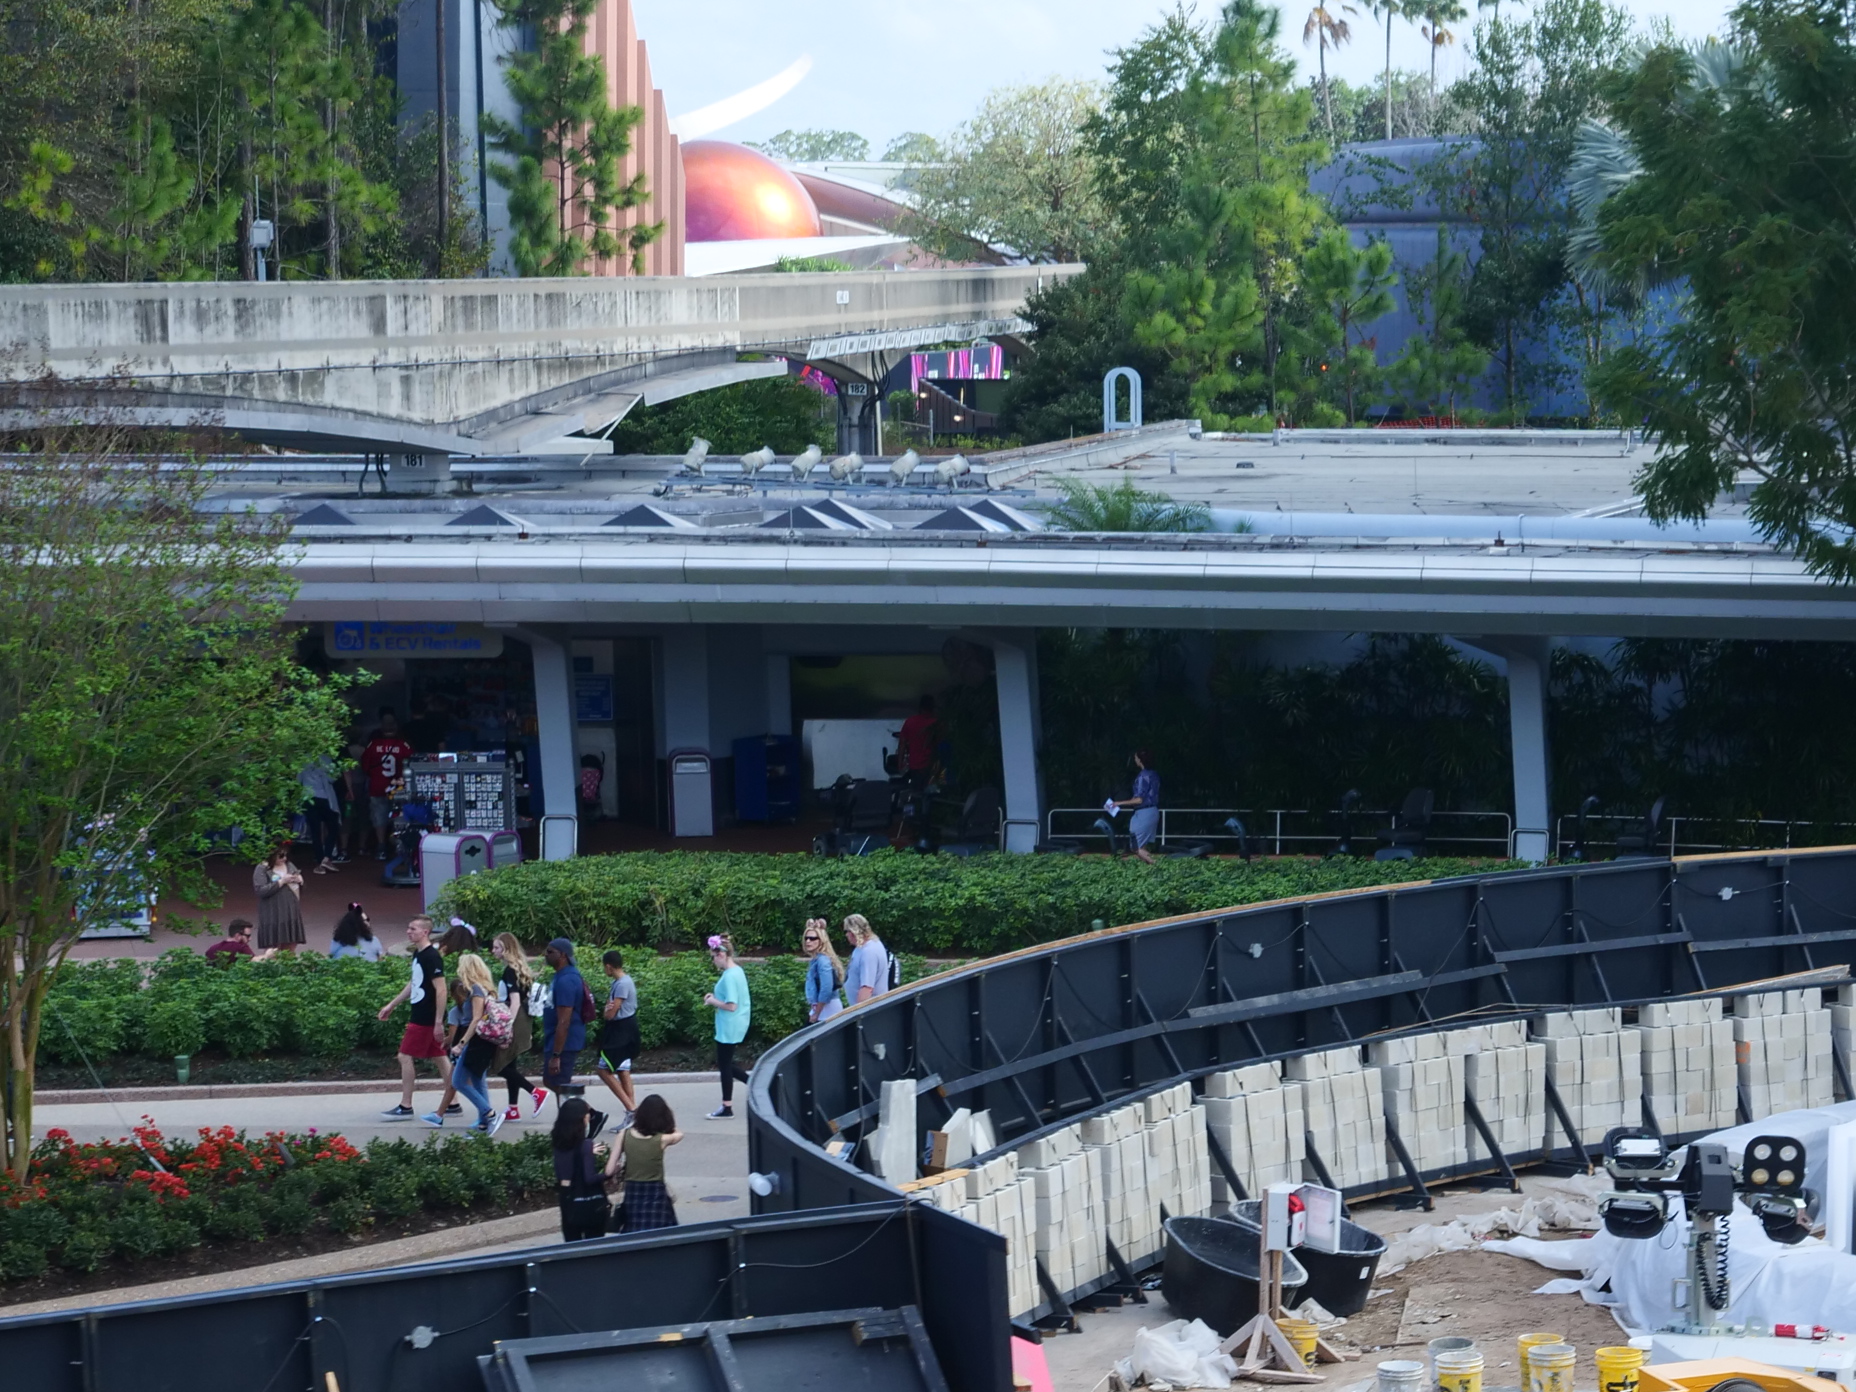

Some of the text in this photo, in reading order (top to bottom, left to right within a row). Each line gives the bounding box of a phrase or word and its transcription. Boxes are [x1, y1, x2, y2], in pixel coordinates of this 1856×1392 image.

[850, 384, 865, 394] 182
[404, 454, 422, 466] 181
[385, 636, 418, 650] ECV
[423, 636, 481, 650] Rentals
[381, 754, 396, 778] 9
